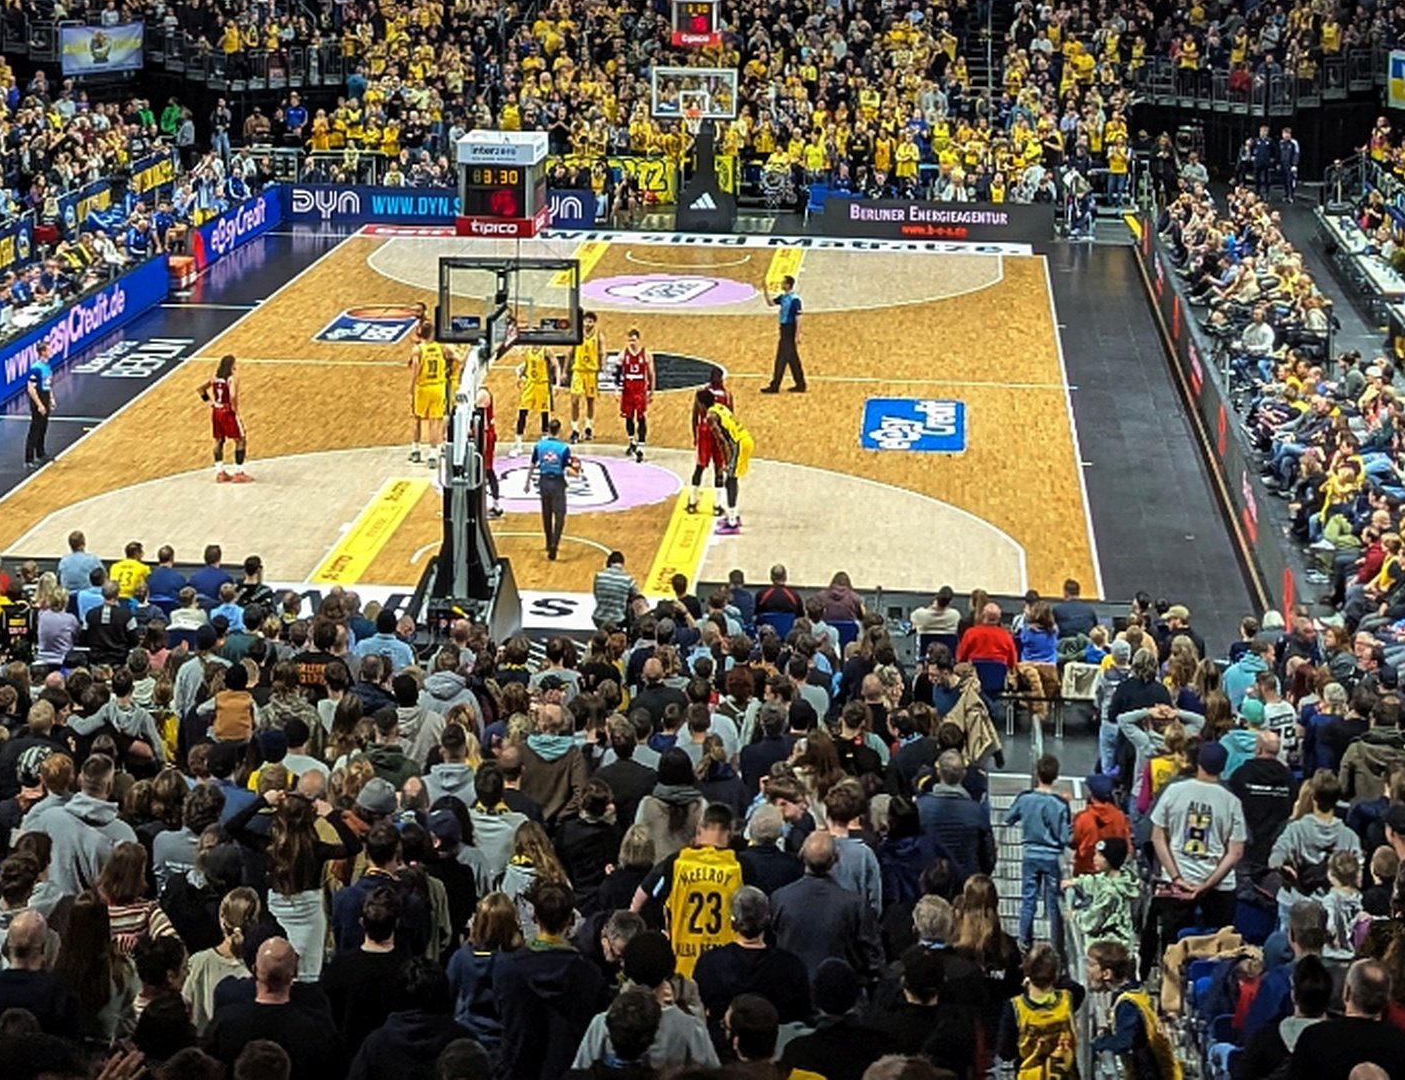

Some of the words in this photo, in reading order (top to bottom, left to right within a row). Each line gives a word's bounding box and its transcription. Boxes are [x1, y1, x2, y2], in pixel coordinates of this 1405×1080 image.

[292, 189, 361, 219] DYN
[209, 197, 267, 255] easyCredit
[469, 219, 519, 235] tipico
[687, 891, 723, 935] 23
